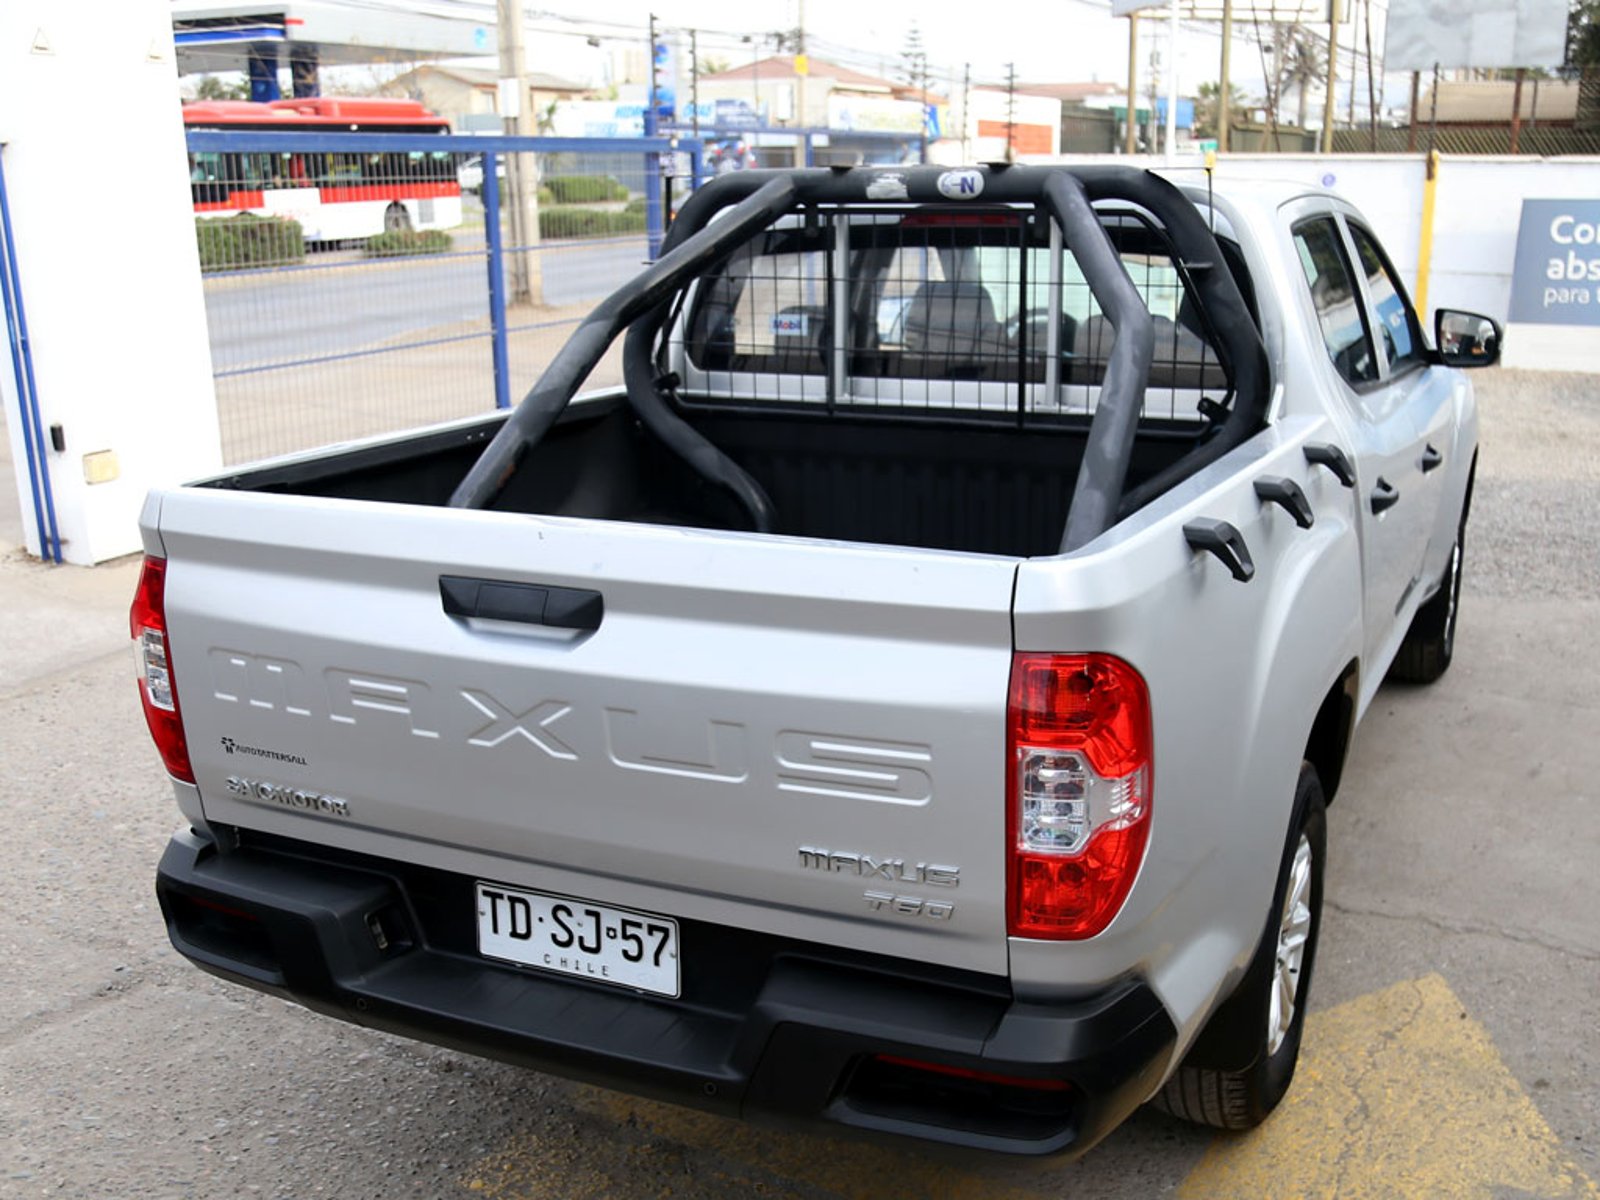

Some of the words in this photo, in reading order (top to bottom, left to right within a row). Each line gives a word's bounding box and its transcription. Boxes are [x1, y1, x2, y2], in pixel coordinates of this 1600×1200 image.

[1549, 213, 1600, 245] Co
[1543, 287, 1590, 309] para
[207, 645, 933, 807] MAXUS
[235, 743, 308, 766] AUTOTATTERSALL
[798, 846, 960, 889] MAXUS
[543, 953, 610, 977] CHILE
